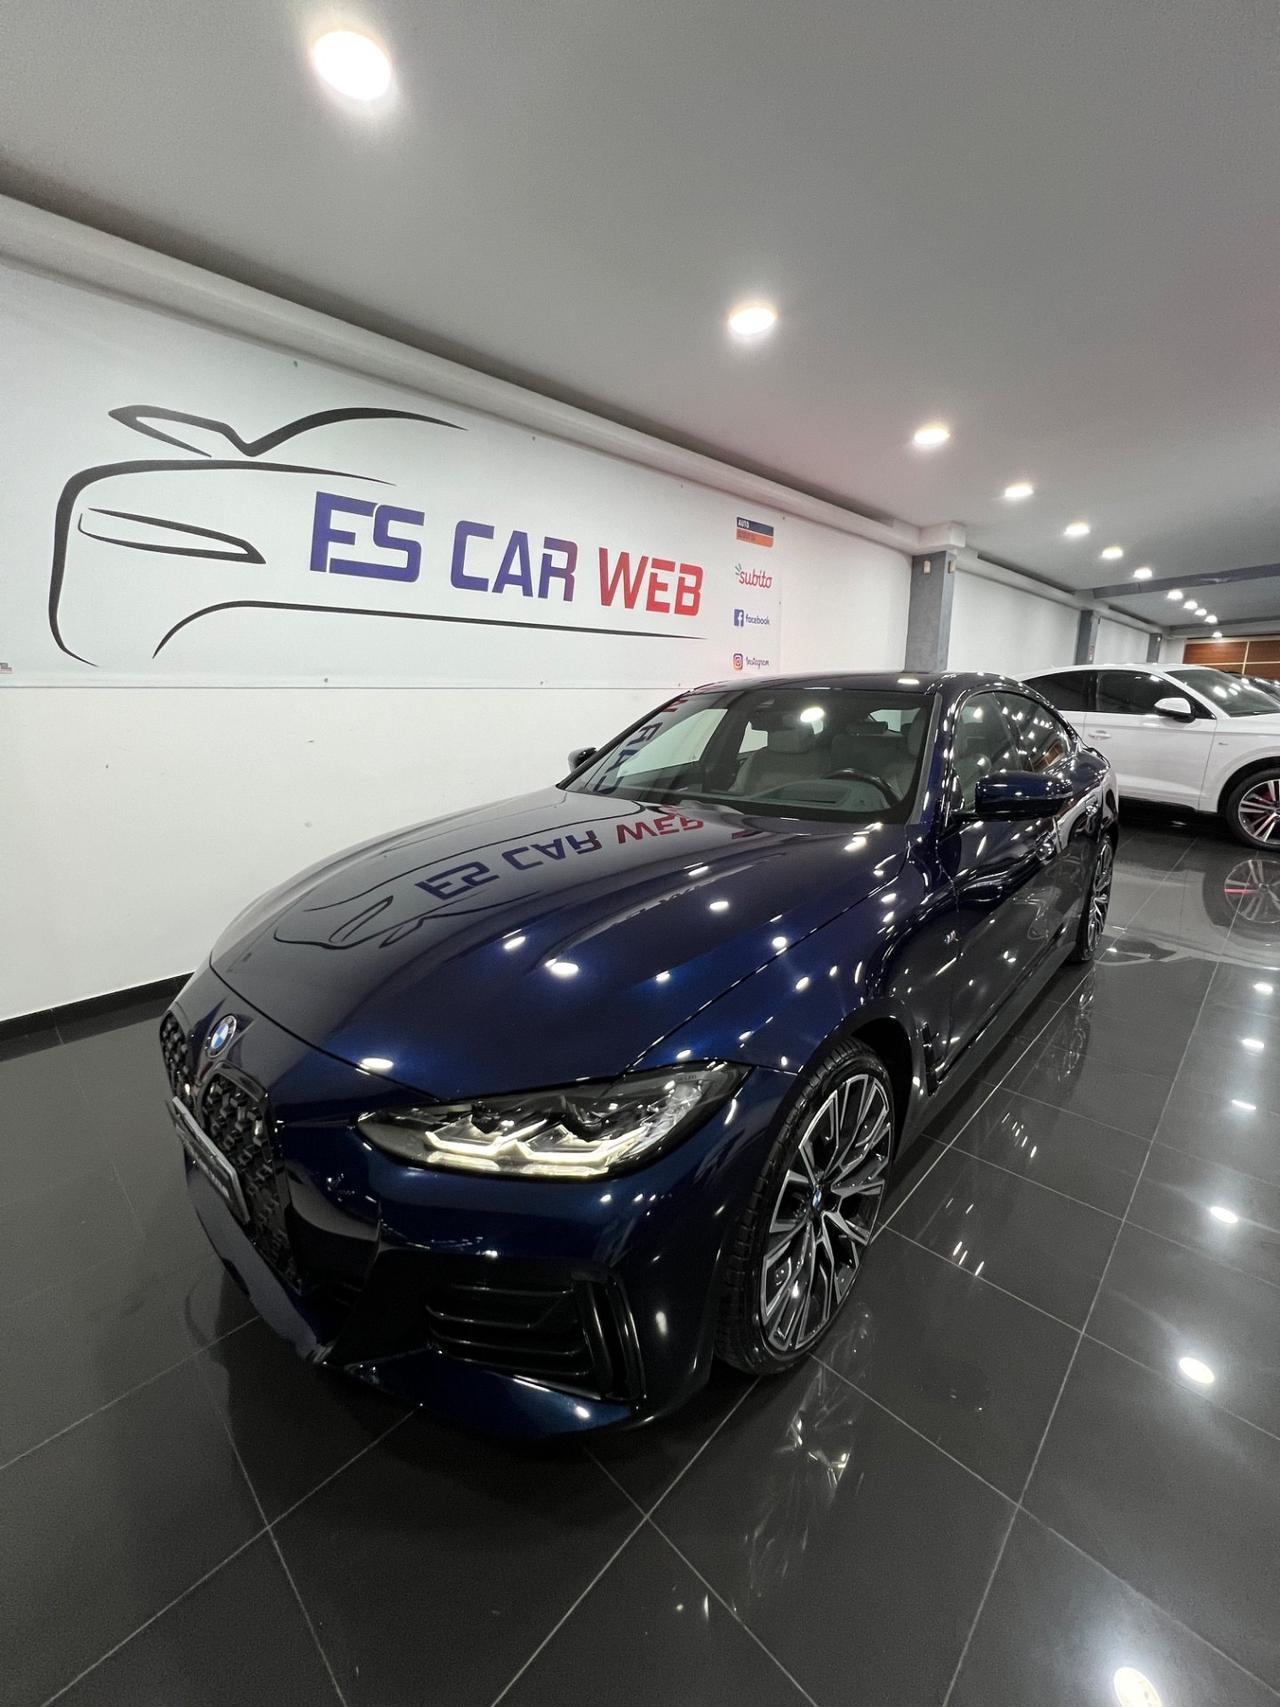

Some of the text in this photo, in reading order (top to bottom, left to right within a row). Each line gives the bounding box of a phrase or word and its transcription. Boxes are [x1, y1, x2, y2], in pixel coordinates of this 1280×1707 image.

[310, 491, 704, 616] ES CAR WEB
[739, 569, 773, 589] subito
[745, 613, 770, 625] facebook
